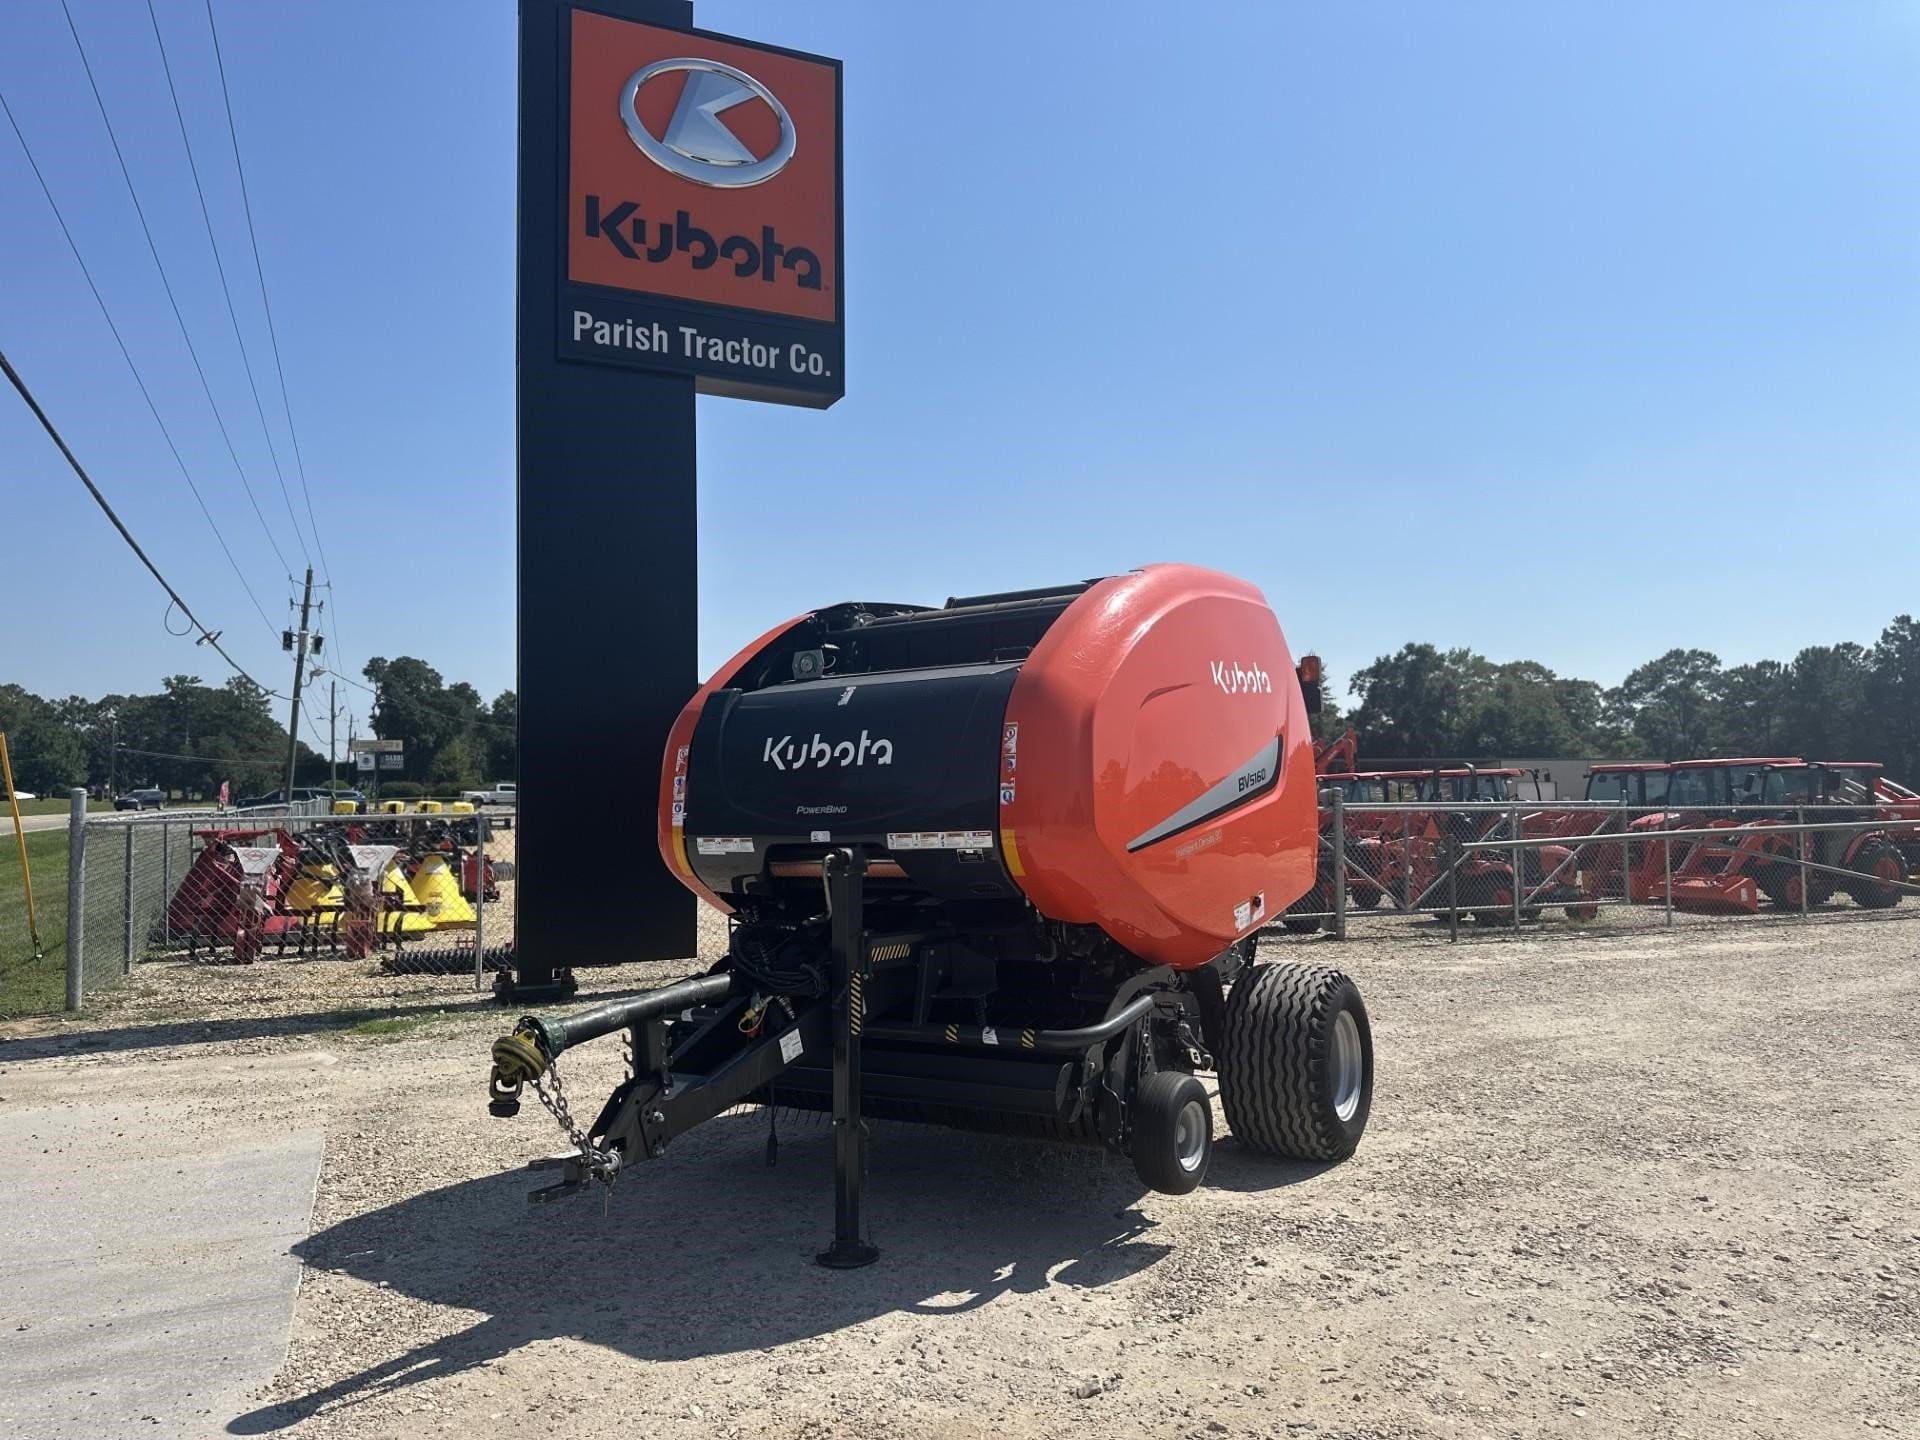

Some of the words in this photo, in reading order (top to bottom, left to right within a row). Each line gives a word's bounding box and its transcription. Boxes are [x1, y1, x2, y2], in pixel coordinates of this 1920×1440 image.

[584, 194, 822, 292] Kubota
[573, 310, 669, 354] Parish
[678, 326, 780, 369] Tractor
[789, 343, 832, 377] Co.
[1210, 660, 1272, 694] Kubota
[763, 730, 893, 770] Kubota
[1238, 768, 1266, 793] BV5160
